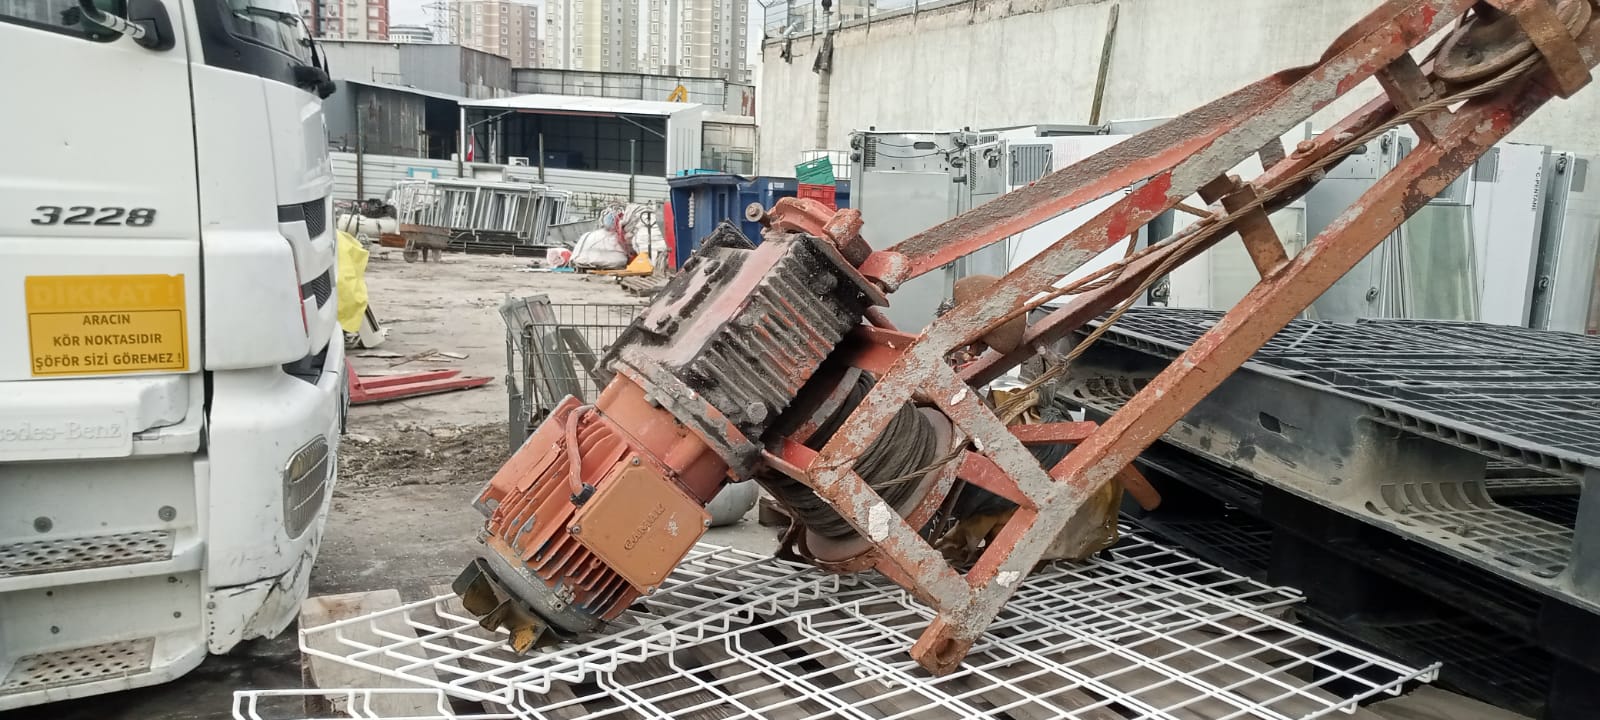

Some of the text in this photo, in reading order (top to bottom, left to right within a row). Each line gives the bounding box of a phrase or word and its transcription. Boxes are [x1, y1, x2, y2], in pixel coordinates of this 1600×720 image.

[30, 205, 157, 227] 3228
[32, 280, 157, 305] DİKKAT
[82, 314, 131, 326] ARACIN
[53, 333, 162, 347] KÖR NOKTASIDIR
[35, 354, 79, 371] ŞÖFÖR
[84, 352, 108, 366] SİZİ
[113, 352, 174, 365] GÖREMEZ
